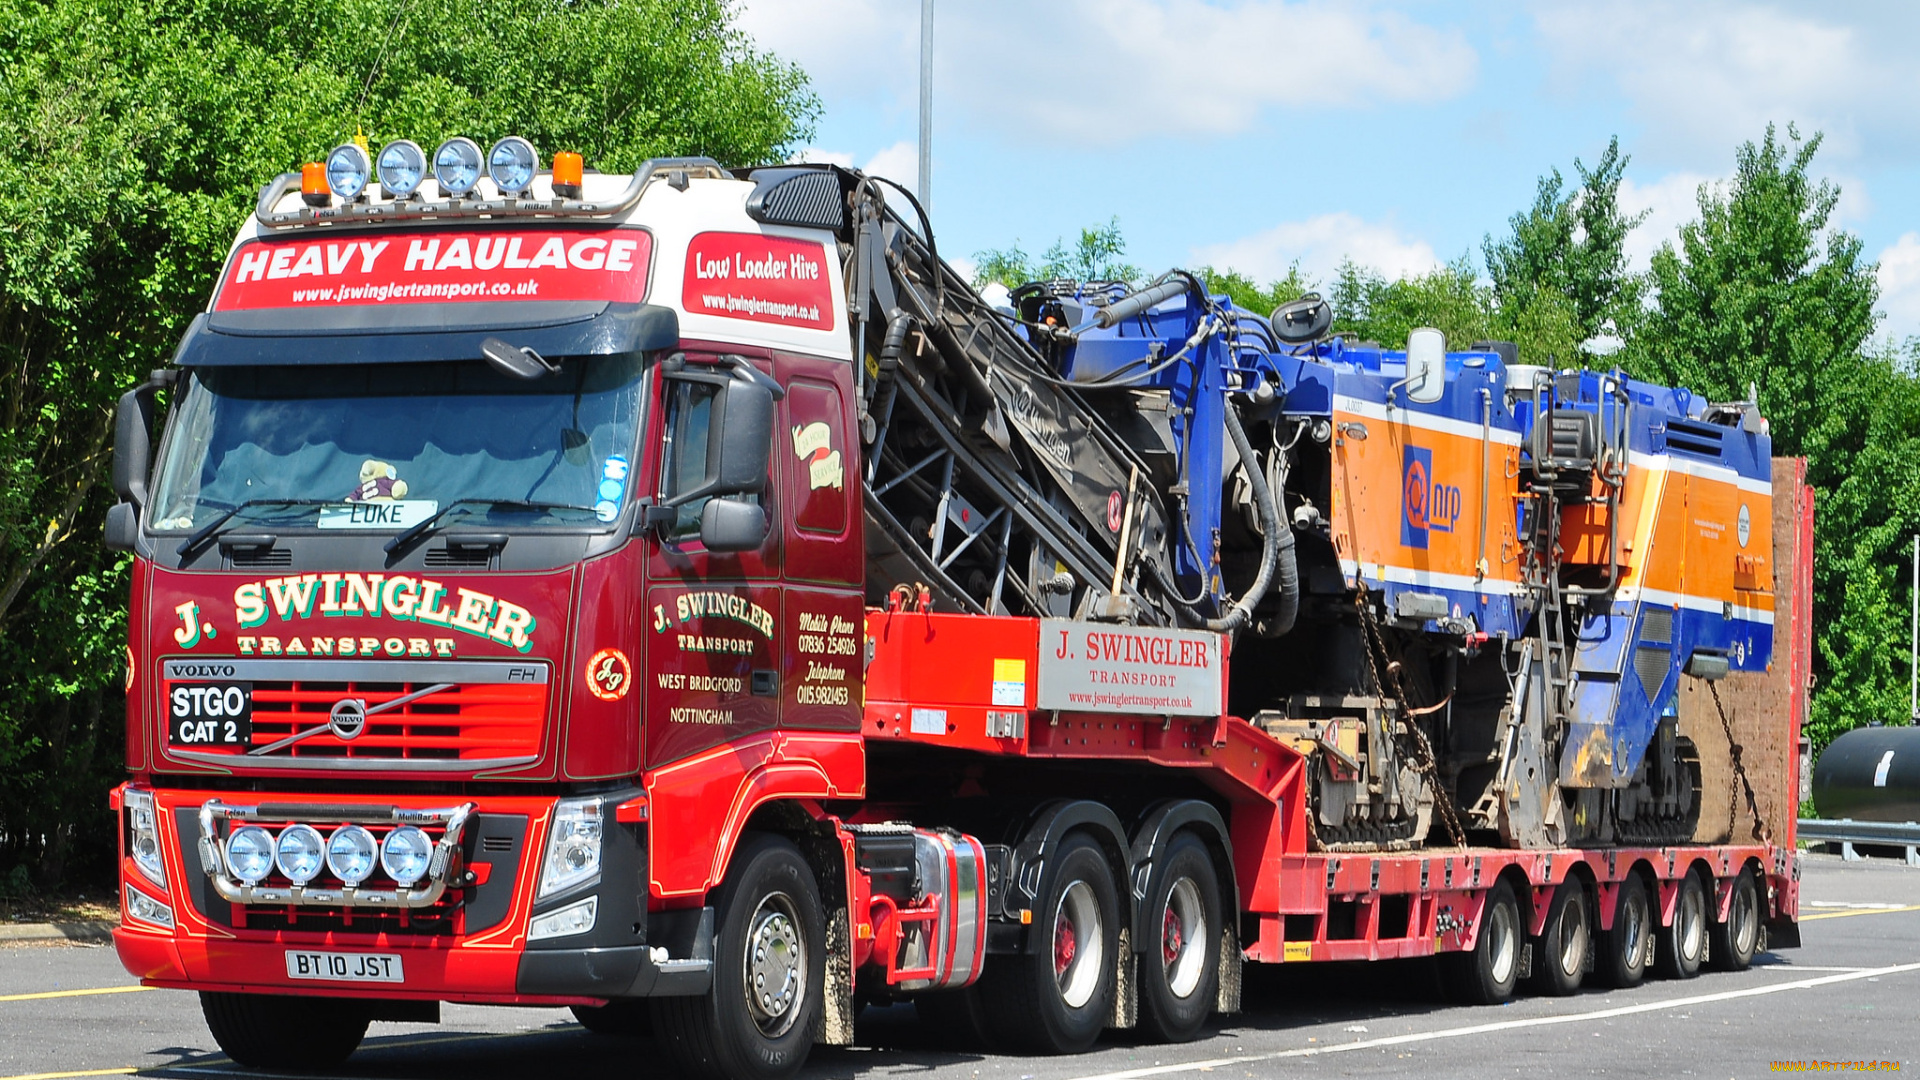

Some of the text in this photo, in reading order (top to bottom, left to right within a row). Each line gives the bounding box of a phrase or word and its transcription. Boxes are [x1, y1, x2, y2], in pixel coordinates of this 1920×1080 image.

[235, 237, 638, 284] HEAVY HAULAGE
[695, 251, 819, 280] Low Loader Hire
[292, 279, 539, 303] www.jswinglertransport.co.uk
[702, 292, 820, 321] www.jswinglertransport.co.uk
[350, 504, 405, 524] LUKE
[1433, 483, 1461, 533] nrp
[173, 572, 538, 654] J. SWINGLER
[653, 591, 775, 641] J. SWINGLER
[799, 612, 855, 636] Mobile Phone
[237, 635, 455, 657] TRANSPORT
[677, 634, 754, 655] TRANSPORT
[798, 635, 856, 656] 07836 254926
[1056, 630, 1209, 668] J. SWINGLER
[170, 665, 236, 677] VOLVO
[507, 668, 537, 681] FH
[805, 660, 846, 683] Telephone
[1089, 670, 1177, 688] TRANSPORT
[657, 673, 742, 693] WEST BRIDGFORD
[172, 686, 245, 718] STGO
[1068, 691, 1193, 710] www.jswinglertransport.co.uk
[331, 715, 363, 724] VOLVO
[669, 707, 734, 725] NOTTINGHAM
[178, 721, 238, 743] CAT 2
[296, 955, 321, 975] BT
[354, 957, 392, 978] JST
